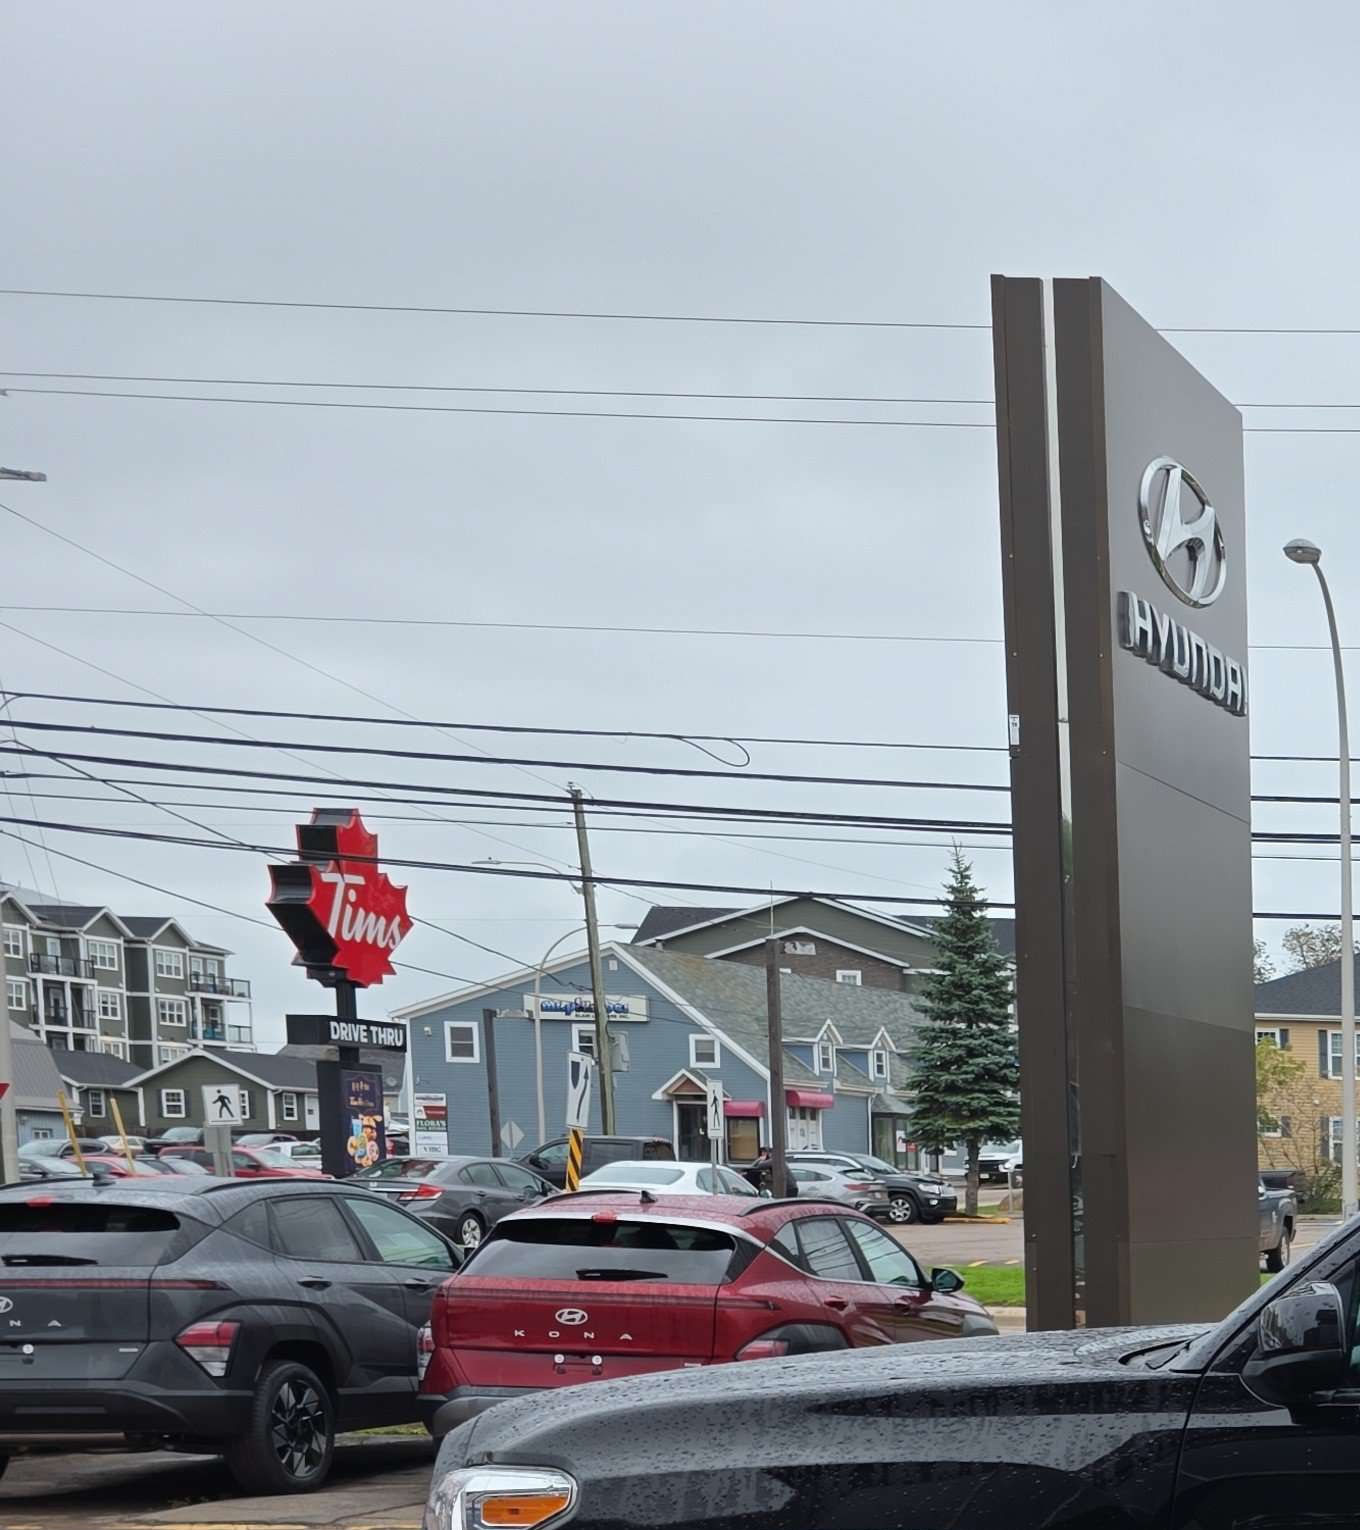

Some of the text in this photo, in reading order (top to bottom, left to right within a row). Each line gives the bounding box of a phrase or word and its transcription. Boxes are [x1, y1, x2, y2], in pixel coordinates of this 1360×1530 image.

[1117, 591, 1248, 717] HYUNDAI
[320, 872, 401, 950] Tims
[329, 1020, 404, 1047] DRIVE THRU
[514, 1329, 633, 1341] KONA
